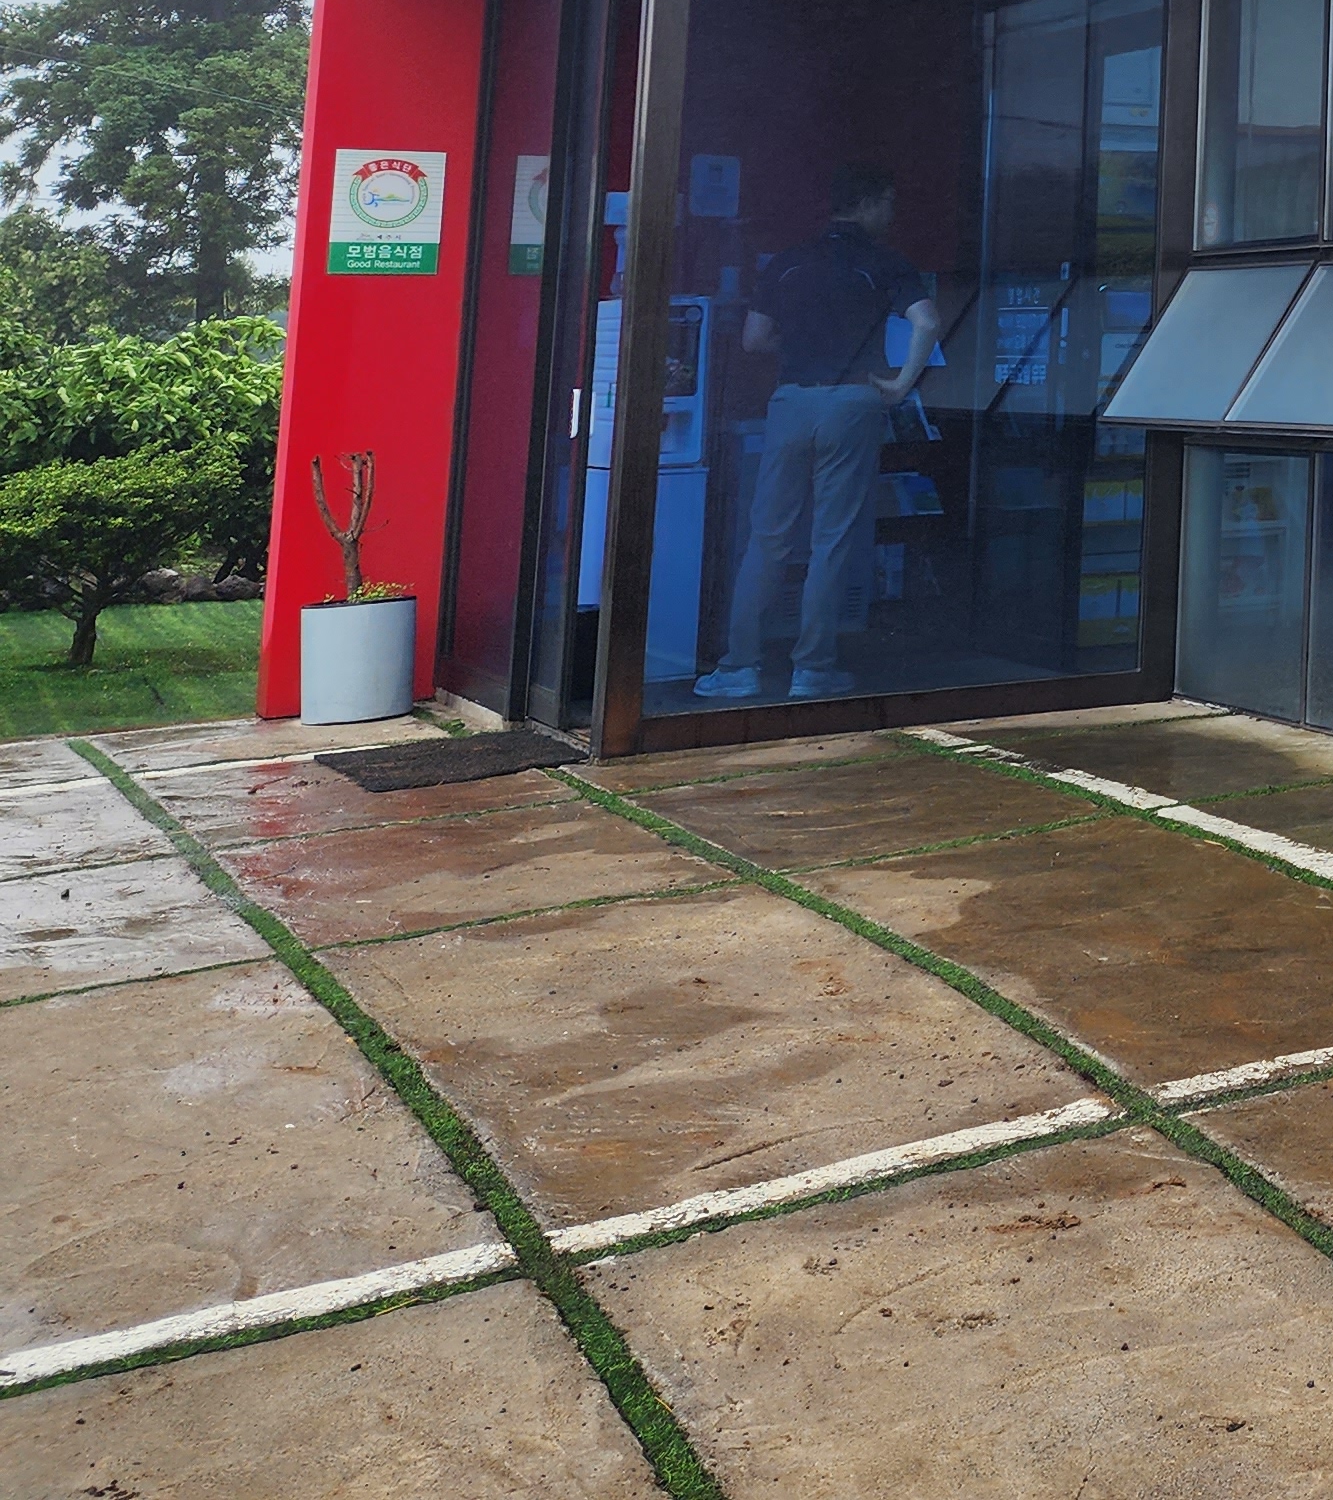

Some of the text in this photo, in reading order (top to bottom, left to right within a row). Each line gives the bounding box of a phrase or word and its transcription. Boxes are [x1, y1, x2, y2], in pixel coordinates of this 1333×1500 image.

[346, 245, 423, 259] 모범음식점
[347, 260, 420, 269] Good Restaurant
